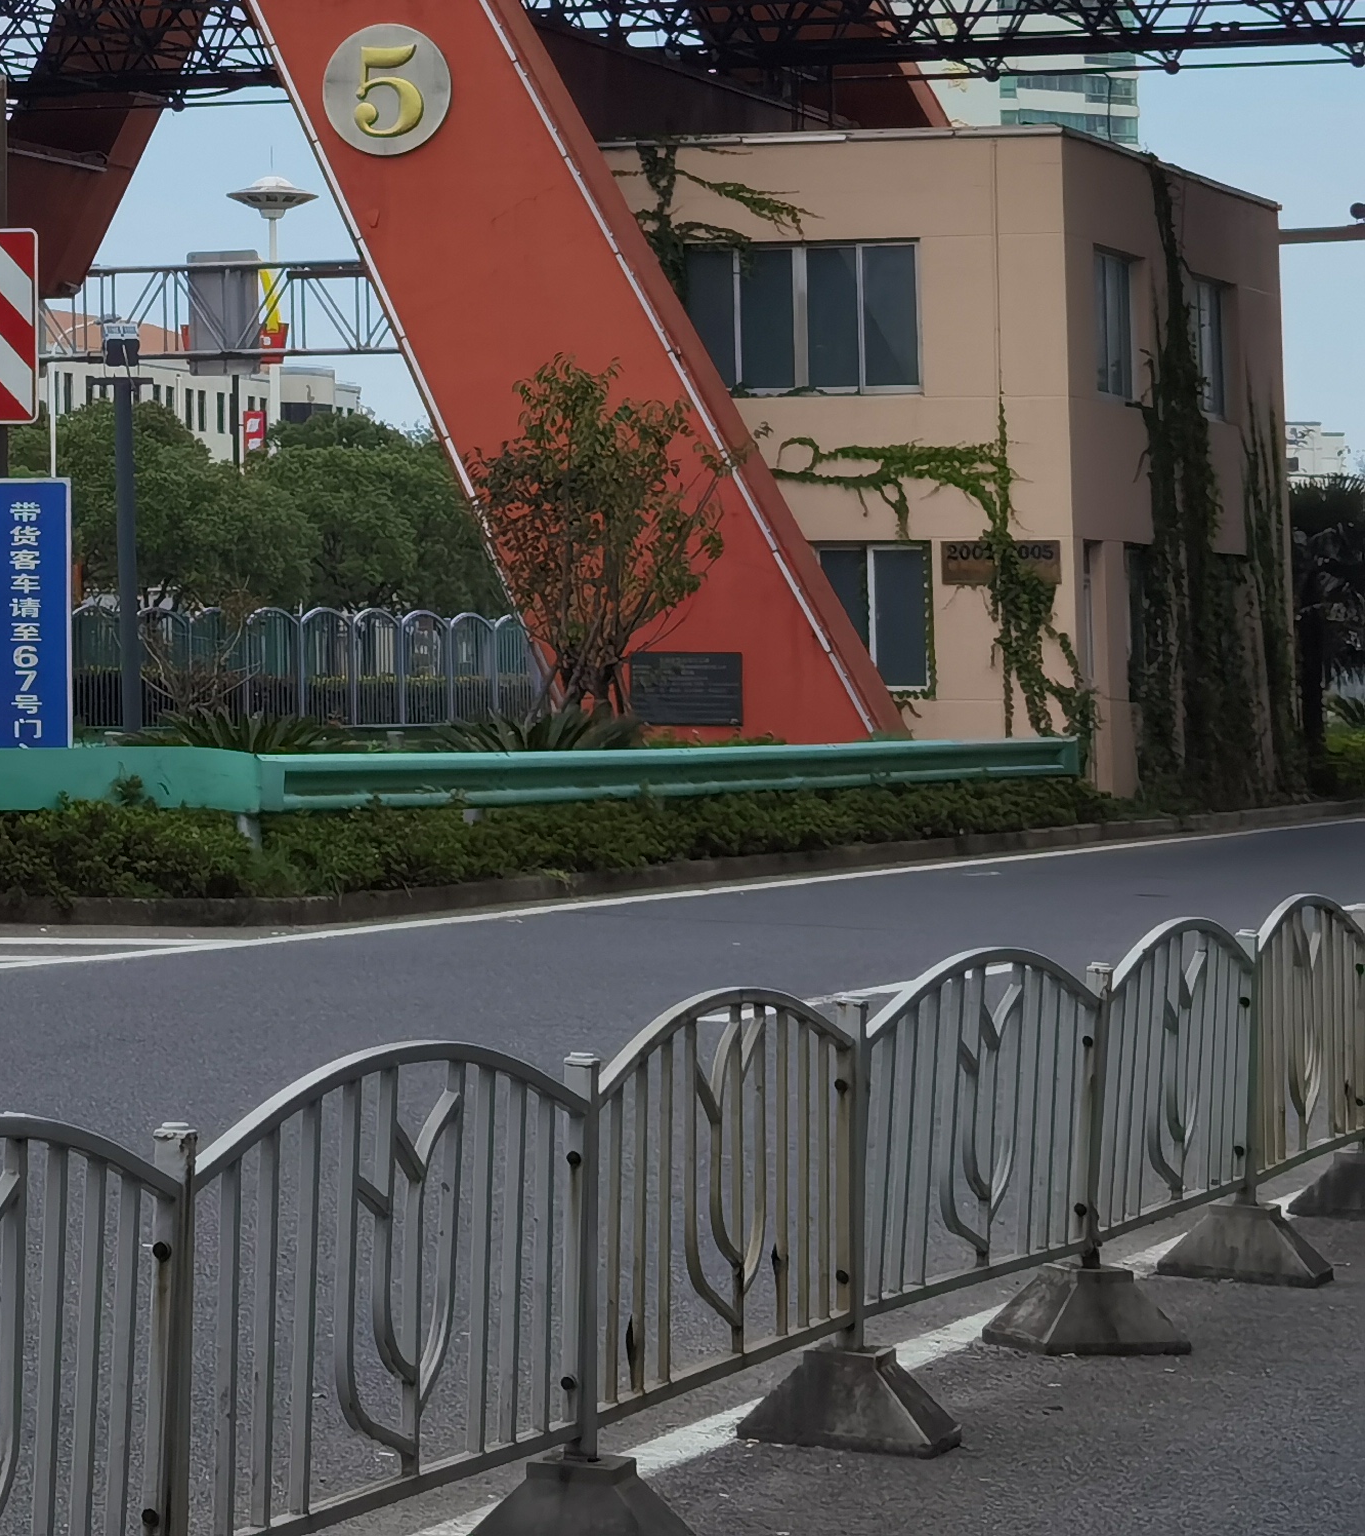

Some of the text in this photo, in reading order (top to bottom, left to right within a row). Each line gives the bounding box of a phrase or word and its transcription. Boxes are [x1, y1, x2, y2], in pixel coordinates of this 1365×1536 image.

[353, 43, 424, 138] 5
[9, 501, 42, 749] 带货客车请至67号门
